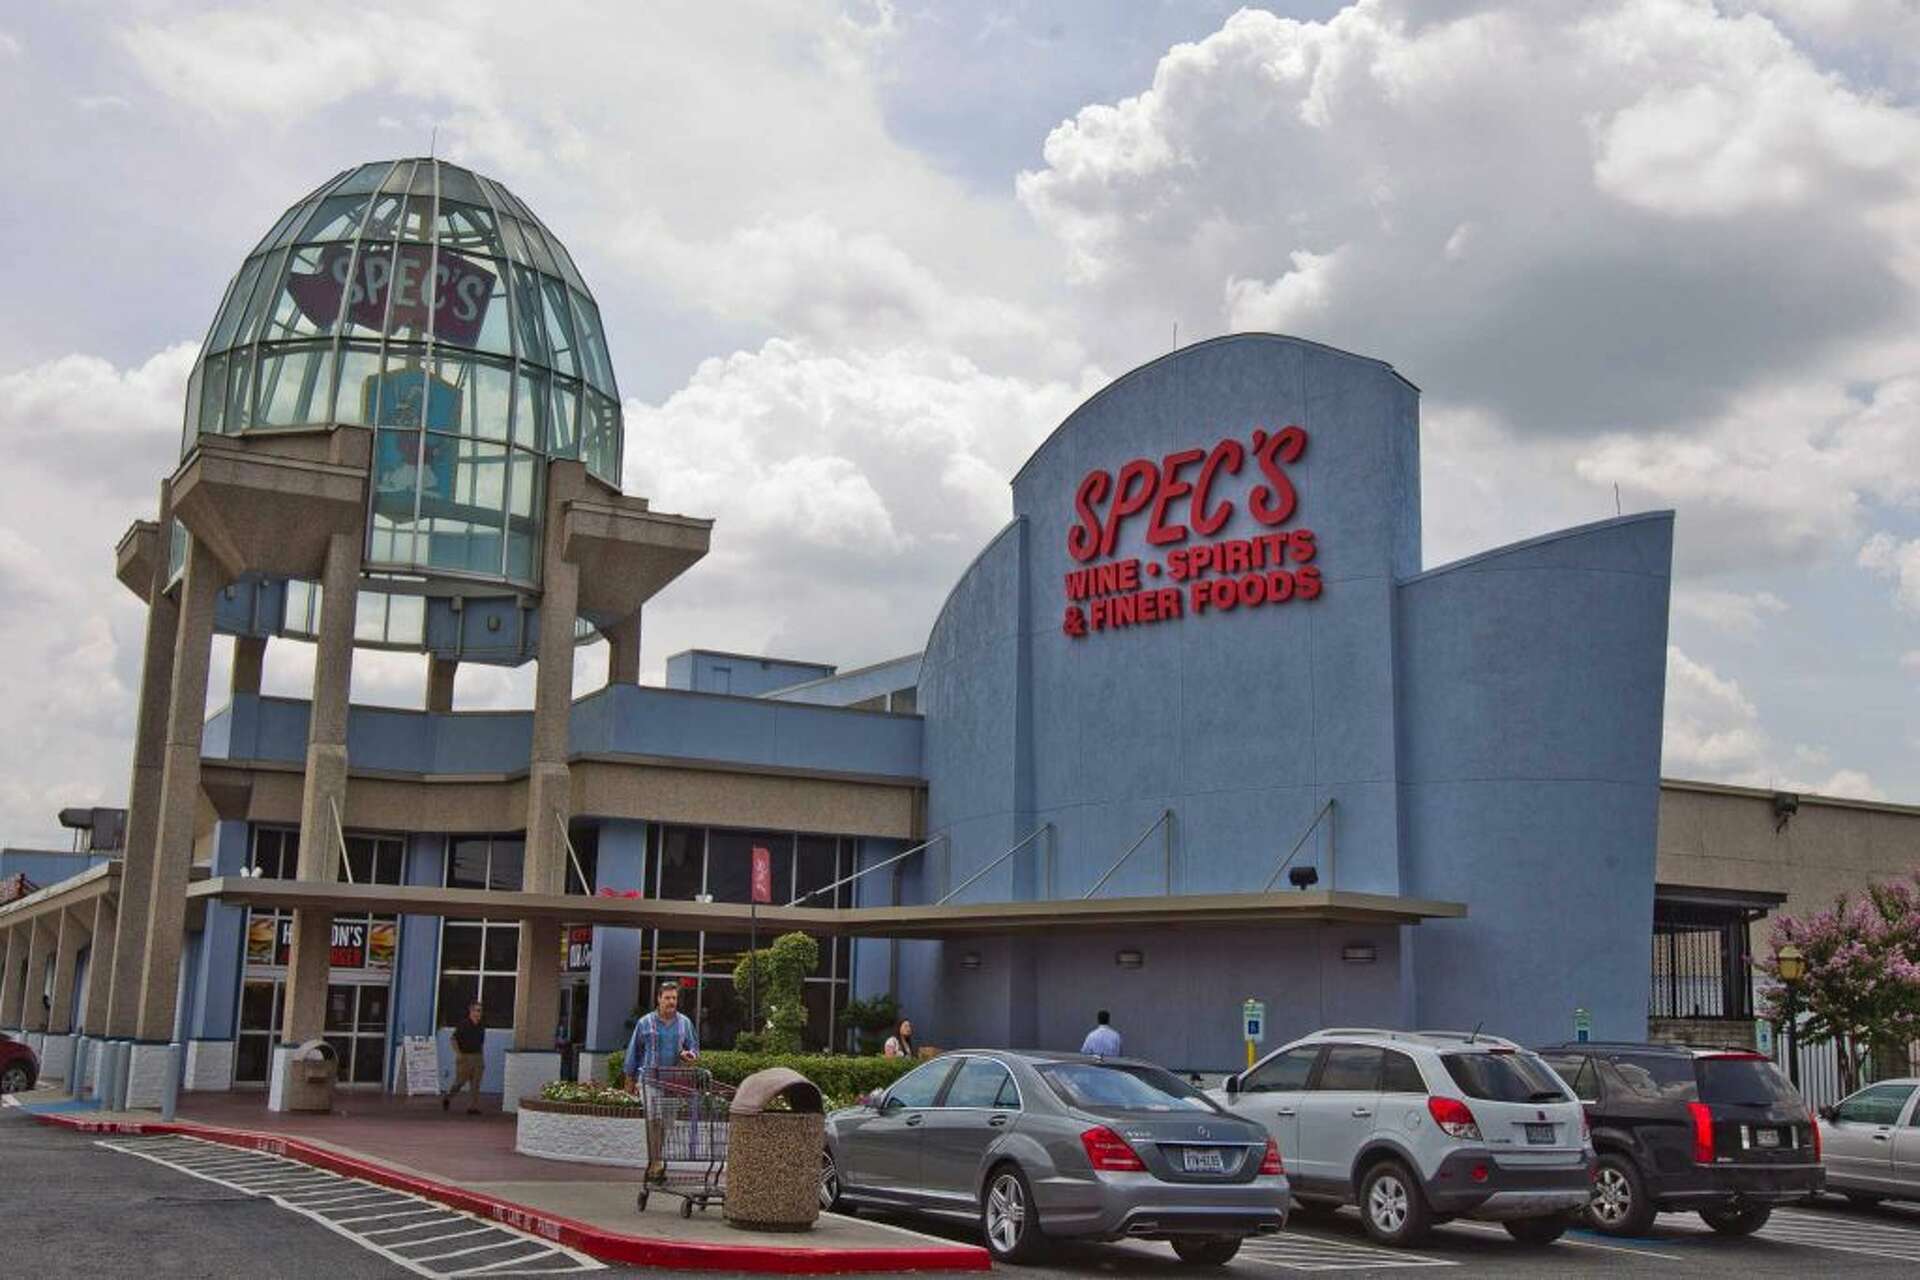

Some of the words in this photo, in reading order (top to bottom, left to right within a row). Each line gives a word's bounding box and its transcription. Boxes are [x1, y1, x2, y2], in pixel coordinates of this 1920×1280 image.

[332, 256, 485, 322] SPEC'S
[1067, 425, 1308, 562] SPEC'S
[1064, 558, 1140, 600] WINE
[1167, 529, 1318, 581] SPIRITS
[1062, 605, 1087, 638] &
[1090, 587, 1183, 631] FINER
[1190, 566, 1323, 614] FOODS
